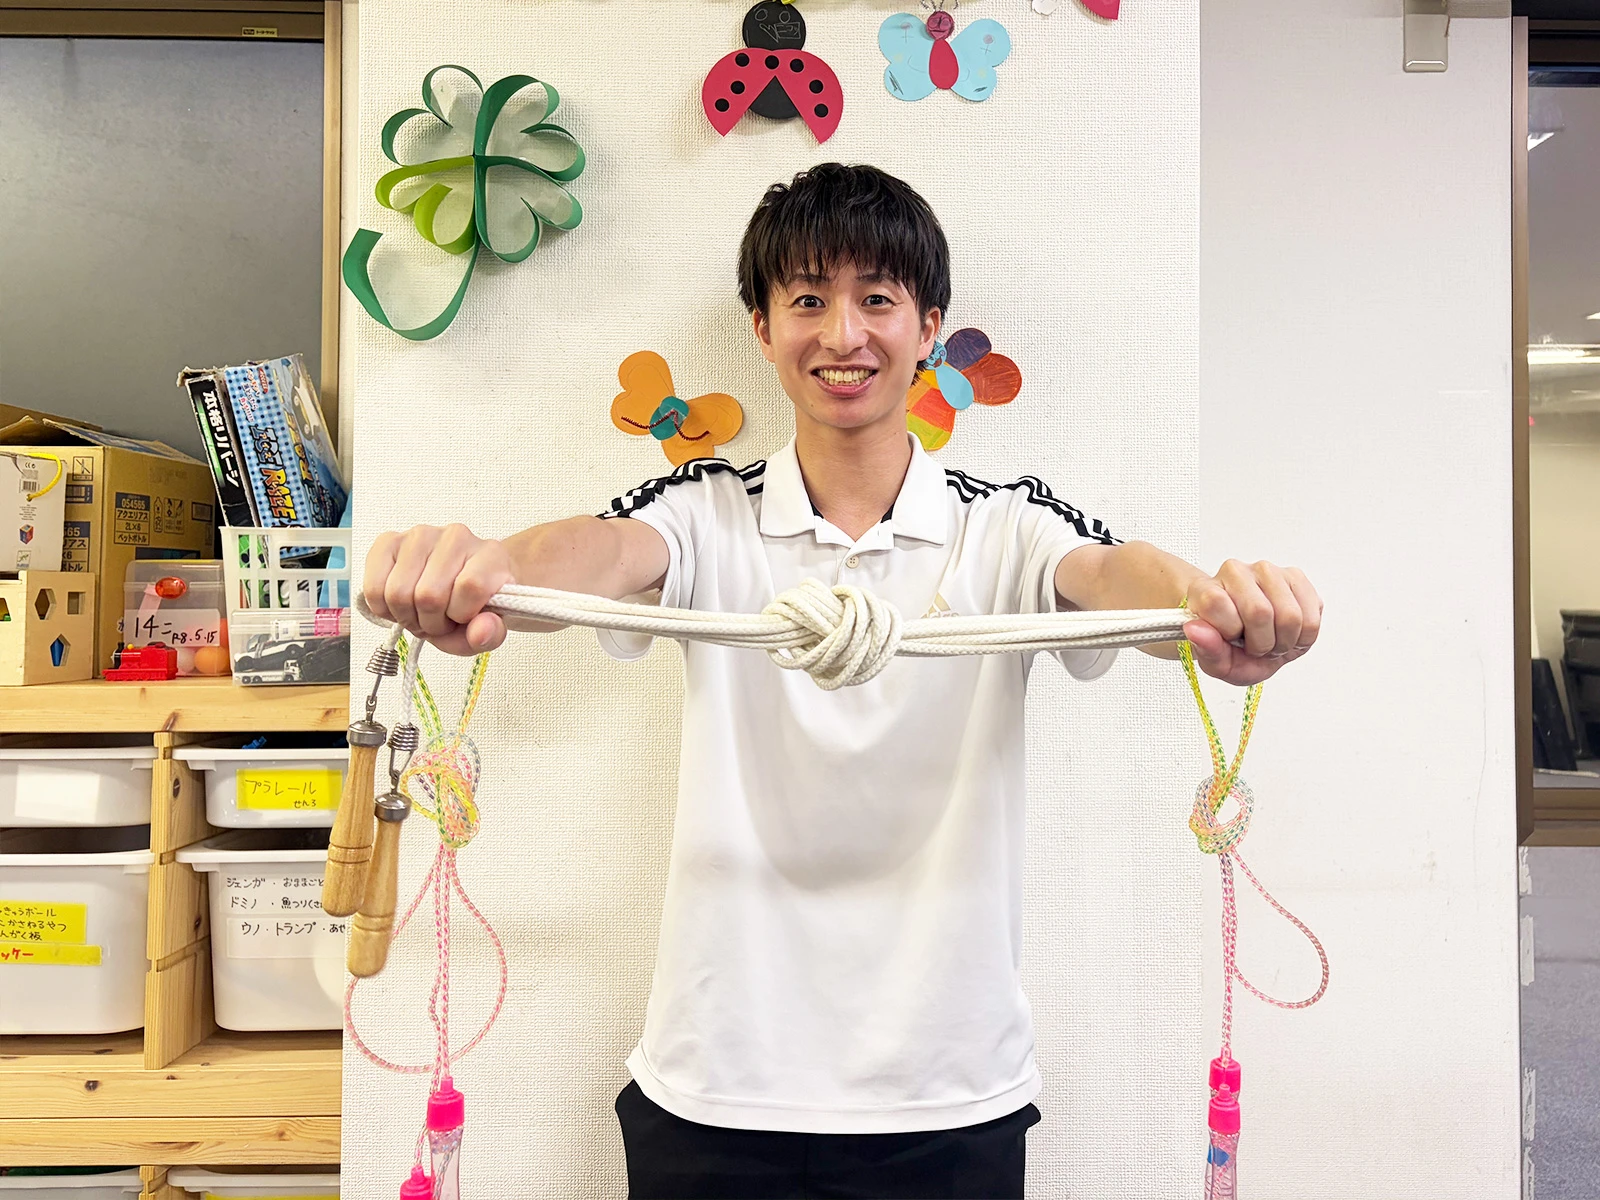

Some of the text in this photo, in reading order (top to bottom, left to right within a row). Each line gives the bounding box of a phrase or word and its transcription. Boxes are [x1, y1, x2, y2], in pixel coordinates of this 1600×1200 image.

[203, 390, 240, 488] 本格リバーシ
[117, 509, 148, 520] アクエリアス
[118, 533, 147, 543] ペットボトル
[245, 779, 316, 796] プラレール
[294, 799, 317, 809] せんろ
[0, 906, 57, 917] きゅうボール
